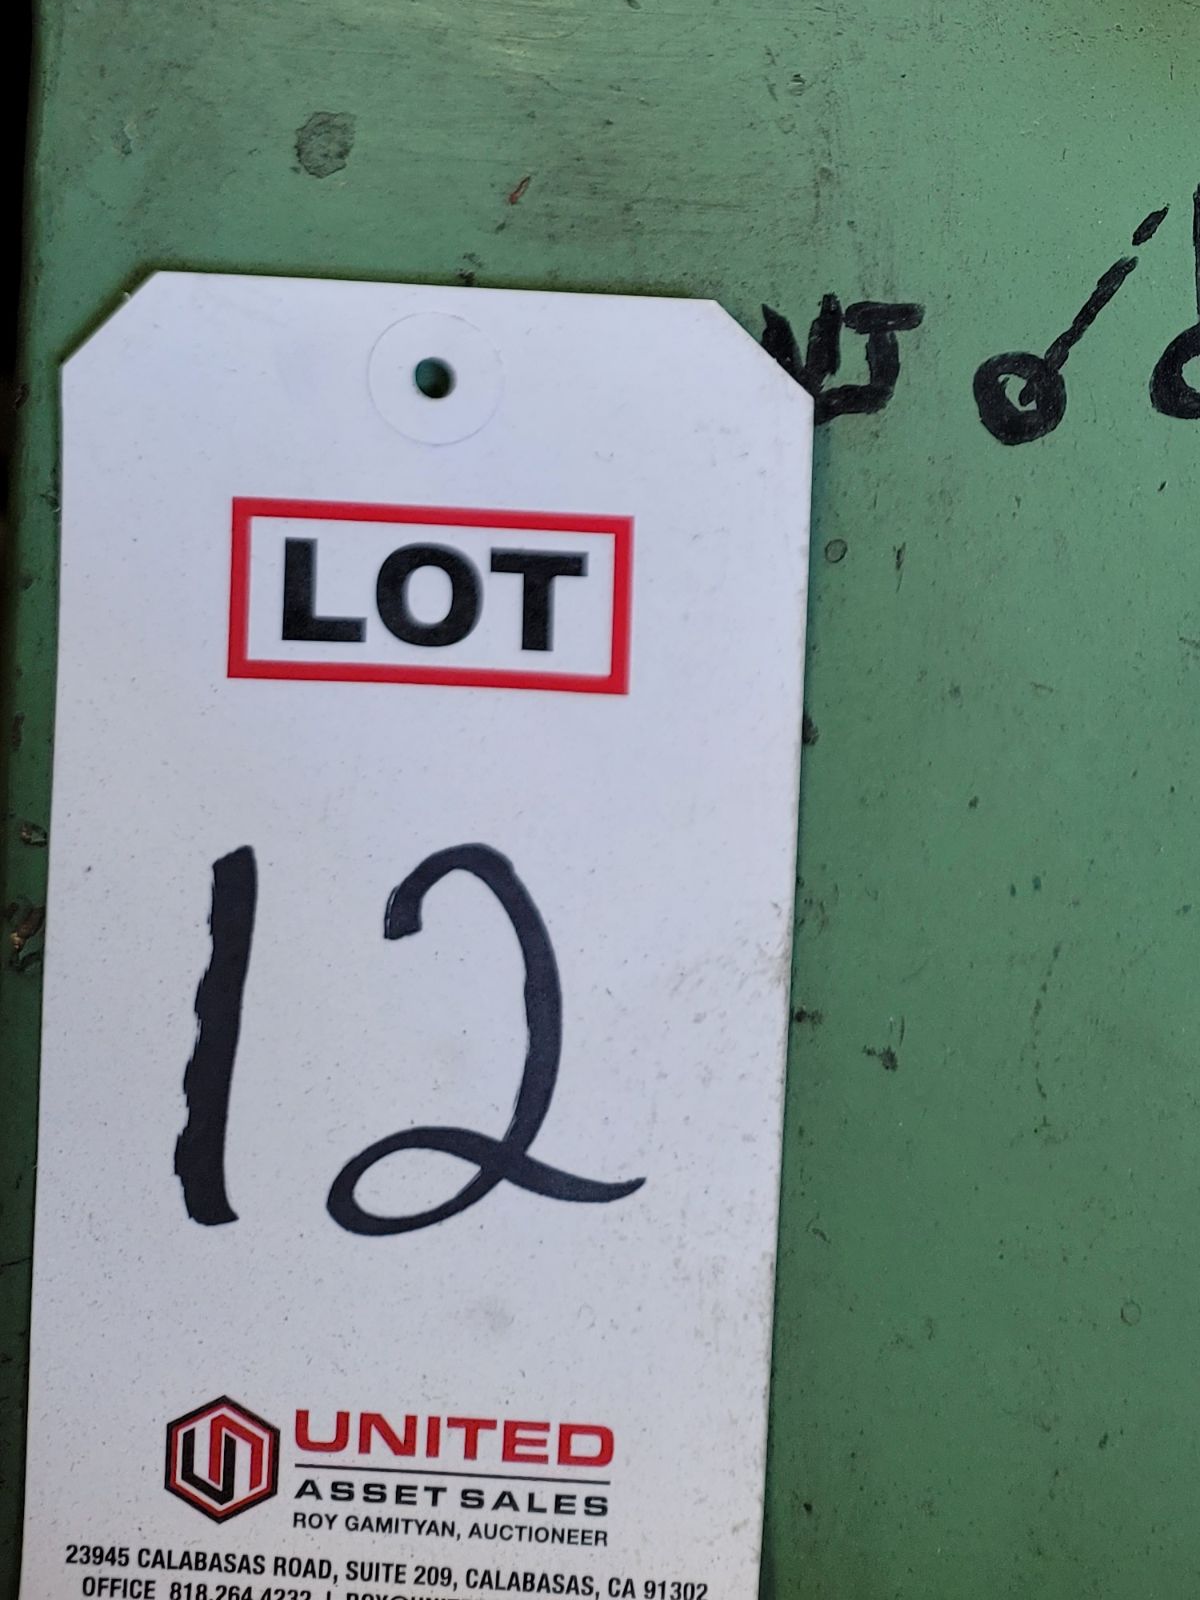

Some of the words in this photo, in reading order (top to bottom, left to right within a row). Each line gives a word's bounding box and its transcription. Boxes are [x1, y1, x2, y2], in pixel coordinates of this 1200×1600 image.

[280, 536, 589, 652] LOT
[174, 842, 647, 1237] 12
[294, 1408, 615, 1468] UNITED
[294, 1478, 458, 1509] ASSET
[461, 1485, 609, 1517] SALES
[293, 1511, 338, 1531] ROY
[345, 1514, 461, 1541] GAMITYAN,
[468, 1523, 609, 1547] AUCTIONEER
[65, 1544, 130, 1567] 23945
[137, 1548, 266, 1576] CALABASAS
[273, 1556, 339, 1584] ROAD,
[345, 1560, 407, 1584] SUITE
[413, 1564, 458, 1590] 209,
[465, 1567, 601, 1597] CALABASAS,
[608, 1576, 636, 1599] CA
[644, 1580, 708, 1600] 91302
[82, 1576, 156, 1600] OFFICE
